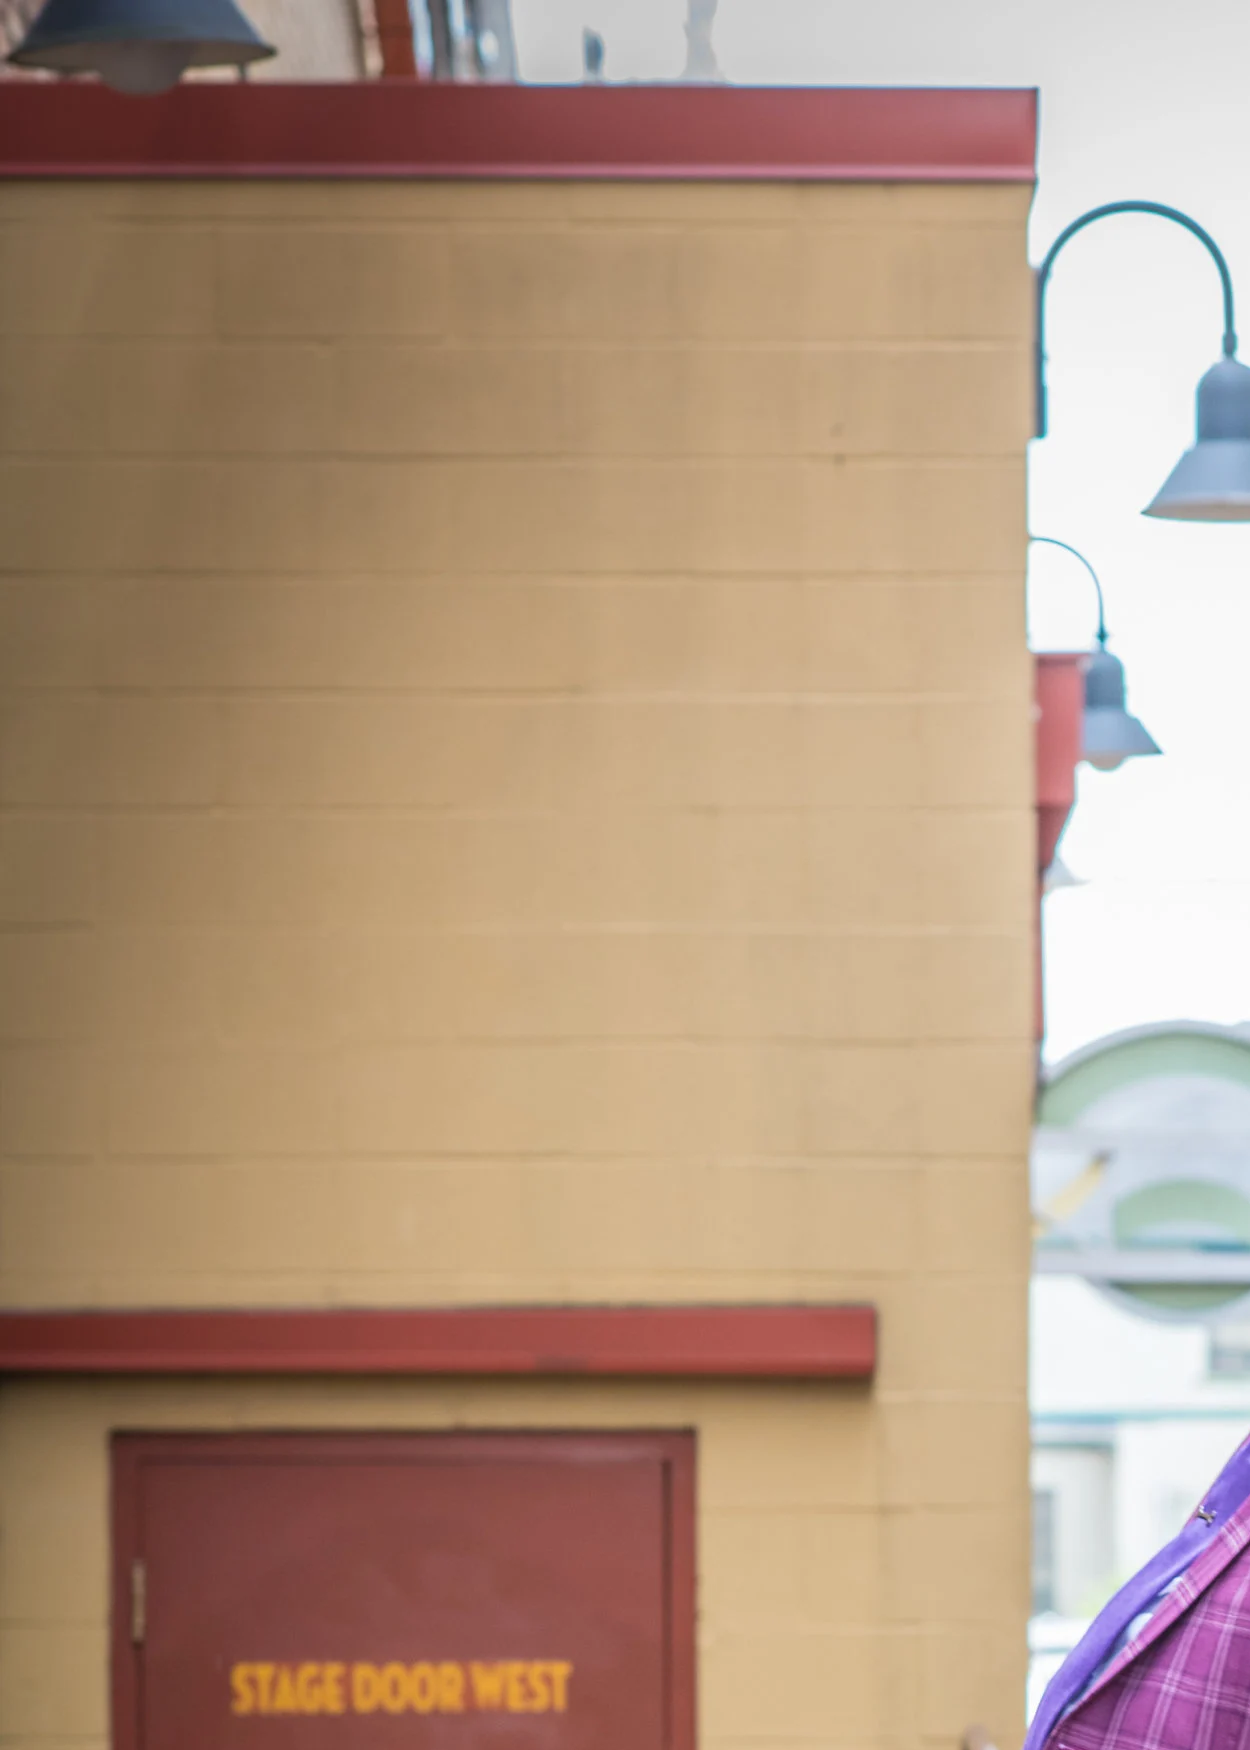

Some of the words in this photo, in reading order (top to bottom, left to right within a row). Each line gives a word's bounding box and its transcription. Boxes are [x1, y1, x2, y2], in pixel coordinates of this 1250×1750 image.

[231, 1661, 346, 1715] STAGE
[352, 1661, 464, 1715] DOOR
[470, 1660, 573, 1713] WEST
